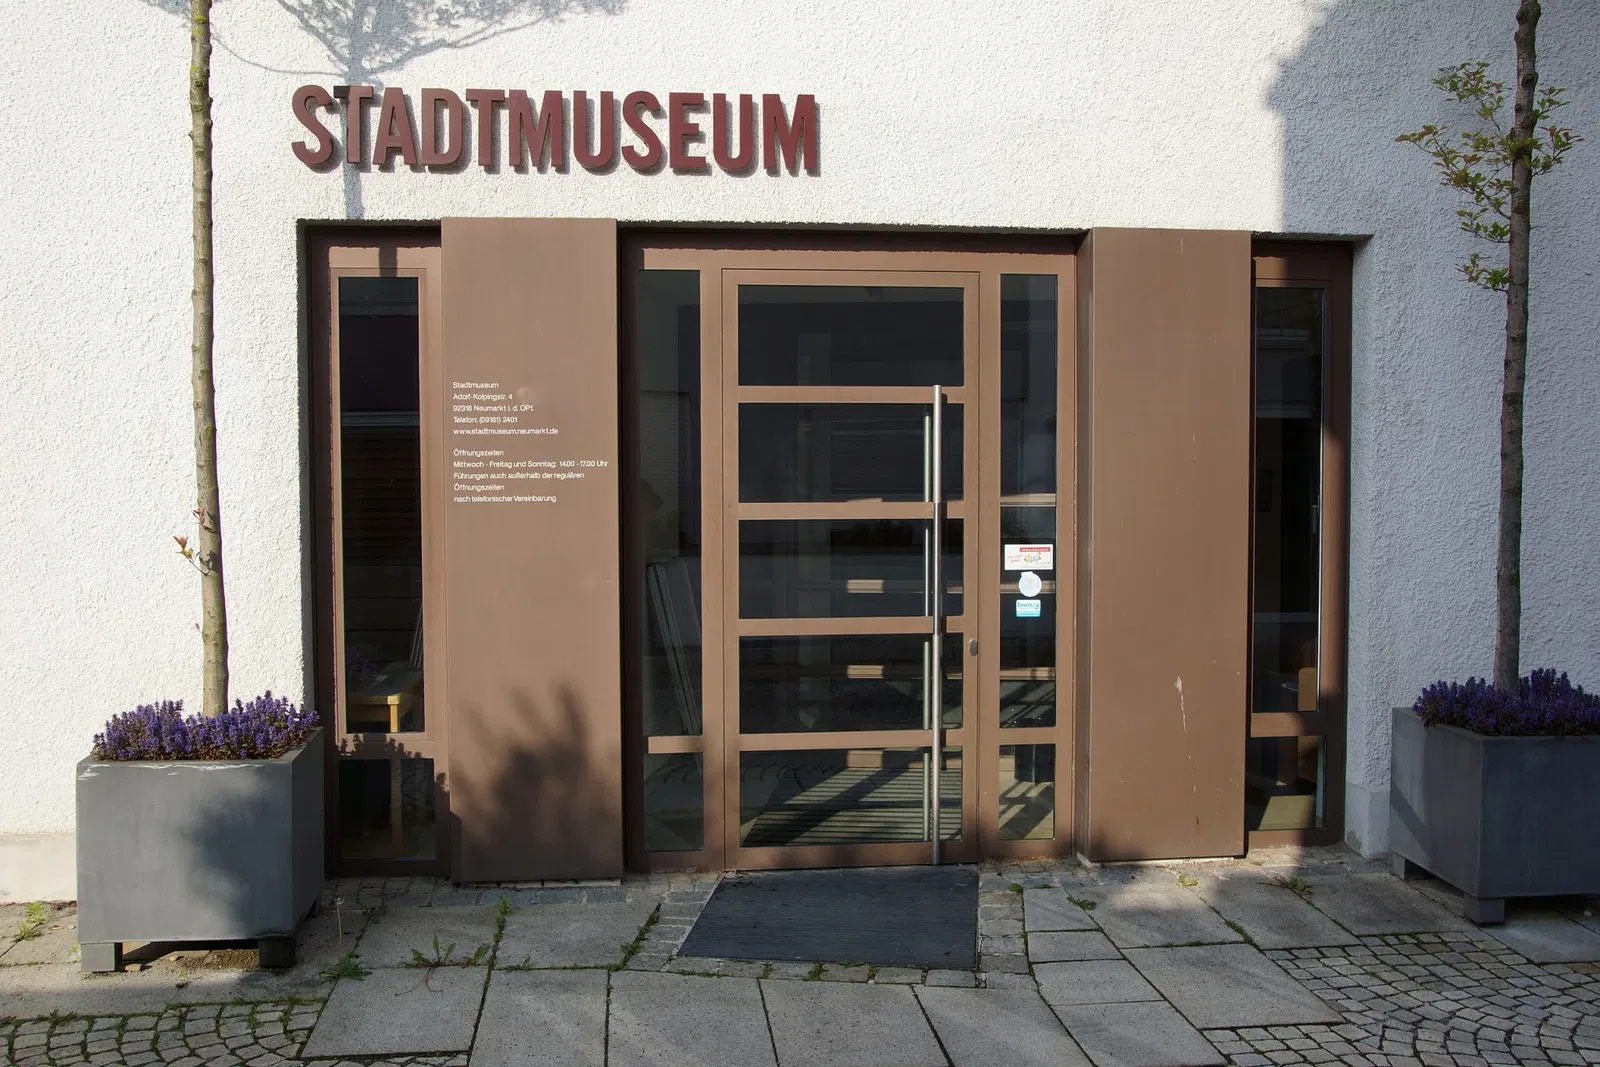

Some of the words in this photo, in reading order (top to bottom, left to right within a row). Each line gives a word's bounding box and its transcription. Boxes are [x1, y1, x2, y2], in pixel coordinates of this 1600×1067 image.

[291, 84, 817, 172] STADTMUSEUM
[453, 381, 499, 389] Stadtmuseum
[453, 393, 507, 401] Adolf-Kolpingstr.
[453, 416, 478, 424] Telefon:
[479, 416, 501, 424] (09181)
[453, 448, 504, 457] Öffnungszeiten
[489, 460, 513, 469] Freitag
[527, 460, 556, 468] Sonntag:
[453, 472, 489, 480] Führungen
[553, 471, 584, 480] regulären
[453, 483, 505, 492] Öffnungszeiten
[513, 494, 556, 503] Vereinbarung
